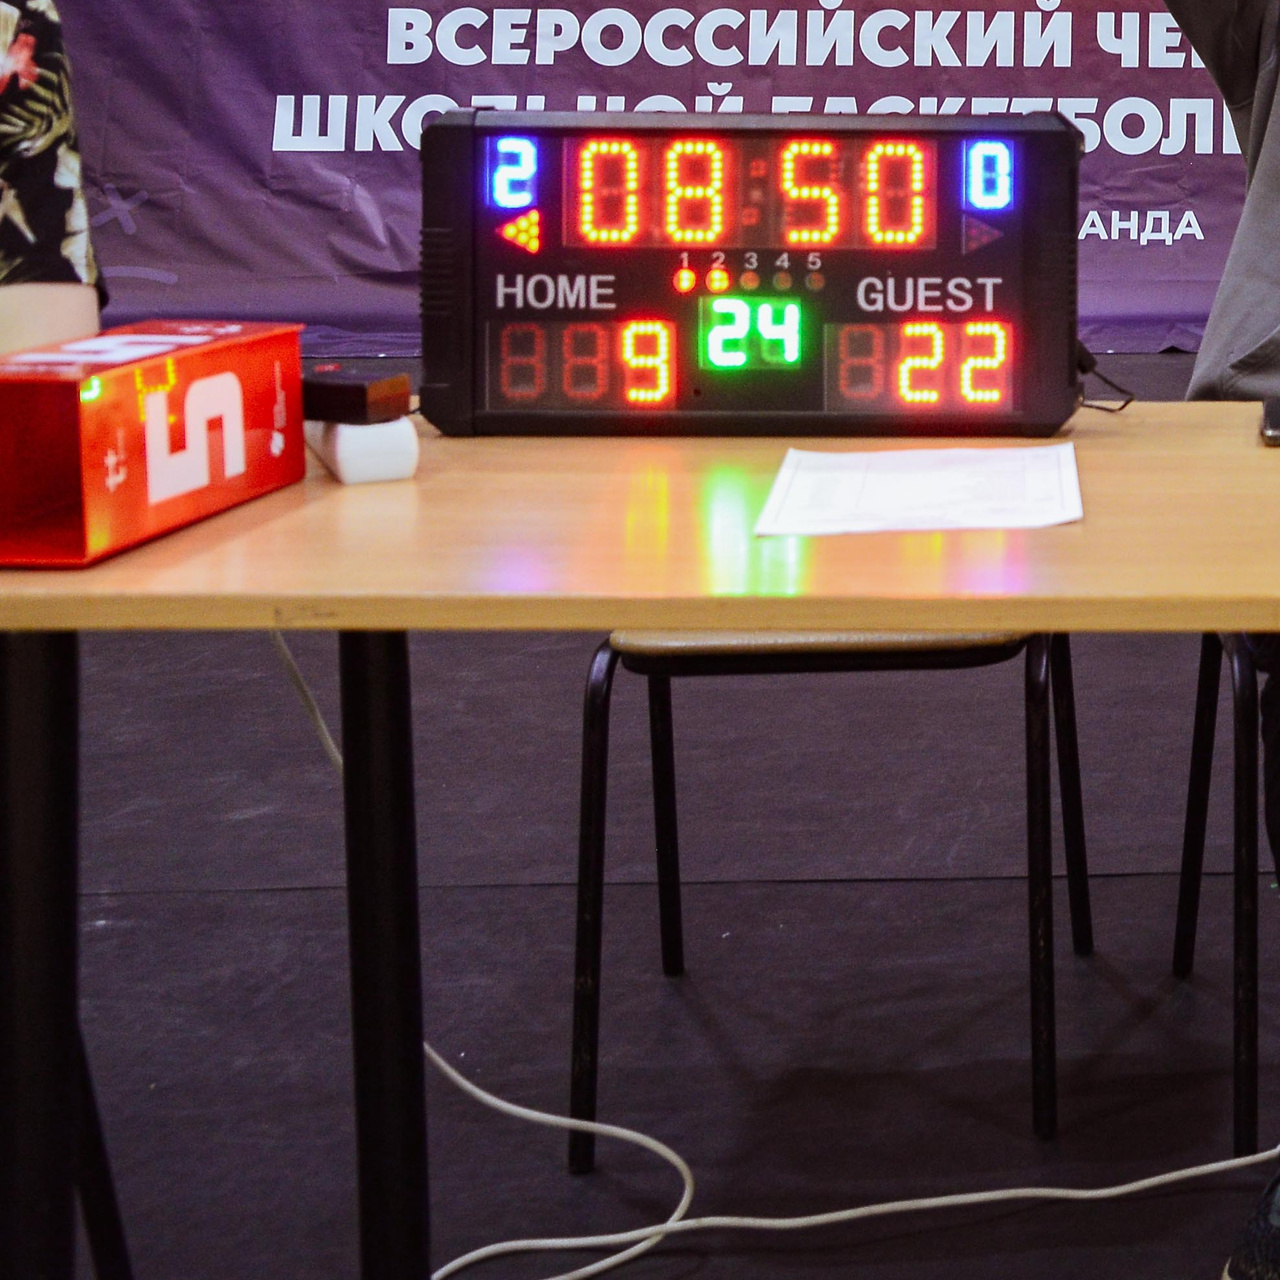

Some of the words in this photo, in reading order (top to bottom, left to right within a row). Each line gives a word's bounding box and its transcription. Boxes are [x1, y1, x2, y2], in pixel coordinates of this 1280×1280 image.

[493, 136, 538, 209] 2
[495, 273, 617, 310] HOME
[679, 251, 690, 269] 1
[711, 251, 726, 270] 2
[744, 252, 759, 270] 3
[774, 252, 791, 270] 4
[806, 252, 822, 270] 5
[856, 276, 1003, 312] GUEST
[621, 319, 670, 403] 9
[707, 297, 801, 368] 24
[897, 322, 1007, 404] 22
